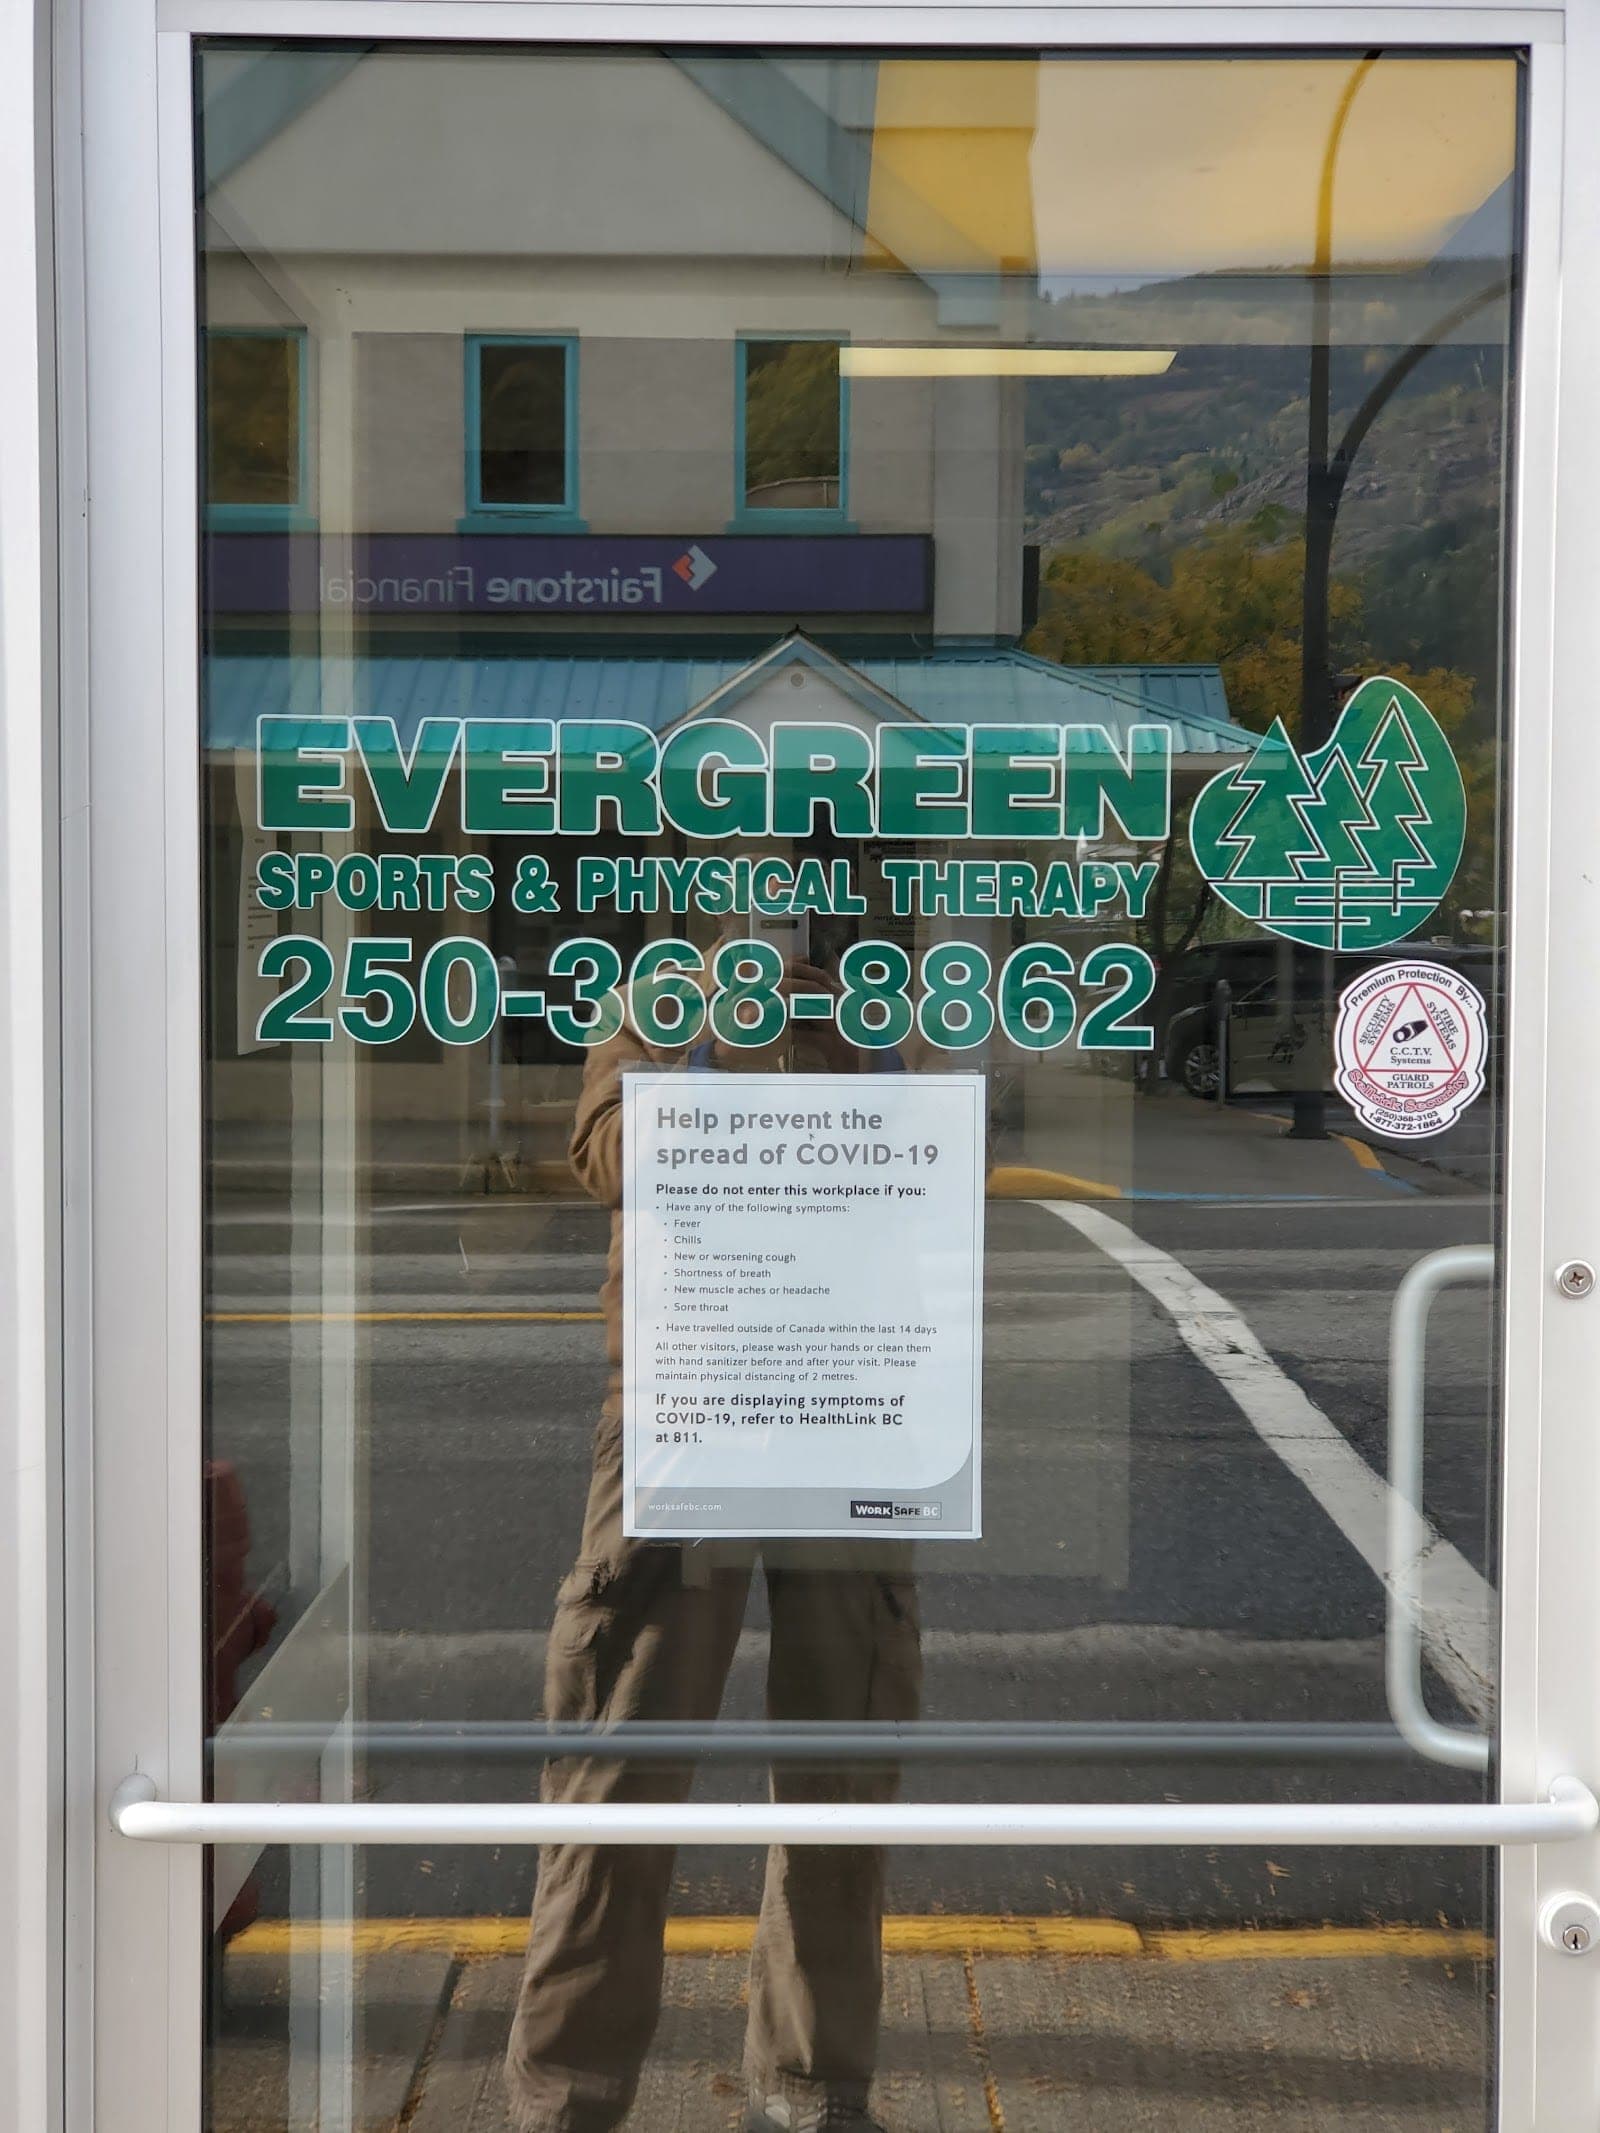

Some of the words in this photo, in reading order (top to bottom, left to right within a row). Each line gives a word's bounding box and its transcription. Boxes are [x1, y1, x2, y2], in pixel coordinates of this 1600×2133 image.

[256, 714, 1173, 841] EVERGREEN
[256, 851, 495, 912] SPORTS
[512, 854, 560, 913] &
[577, 856, 867, 916] PHYSICAL
[881, 859, 1161, 918] THERAPY
[255, 935, 1157, 1052] 250-368-8862
[1351, 973, 1395, 1007] Premium
[1398, 970, 1452, 988] Protection
[1360, 995, 1391, 1045] SECURITY
[1368, 1002, 1396, 1046] SYSTEMS
[1427, 1001, 1456, 1050] SYSTEMS
[1440, 1008, 1459, 1035] FIRE
[1390, 1047, 1432, 1056] C.C.T.V.
[1391, 1056, 1431, 1065] Systems
[1404, 1071, 1469, 1113] Security
[657, 1108, 718, 1134] Help
[730, 1111, 832, 1134] prevent
[841, 1109, 882, 1129] the
[657, 1144, 748, 1169] spread
[759, 1143, 787, 1165] of
[797, 1144, 938, 1166] COVID-19
[656, 1184, 698, 1195] Please
[702, 1184, 718, 1195] do
[723, 1186, 744, 1195] not
[748, 1186, 780, 1196] enter
[784, 1184, 807, 1196] this
[812, 1184, 880, 1198] workplace
[884, 1184, 894, 1196] if
[897, 1186, 926, 1198] you:
[666, 1203, 691, 1212] Have
[694, 1205, 711, 1214] any
[715, 1203, 725, 1212] of
[728, 1203, 744, 1212] the
[747, 1203, 792, 1214] following
[796, 1204, 850, 1214] symptoms:
[674, 1219, 701, 1228] Fever
[674, 1235, 701, 1244] Chills
[674, 1252, 695, 1261] New
[712, 1253, 762, 1263] worsening
[766, 1253, 796, 1263] cough
[674, 1269, 723, 1278] Shortness
[727, 1268, 737, 1278] of
[740, 1269, 771, 1278] breath
[674, 1286, 696, 1294] New
[699, 1286, 734, 1295] muscle
[738, 1286, 767, 1295] aches
[783, 1286, 830, 1295] headache
[674, 1303, 696, 1312] Sore
[699, 1303, 728, 1312] throat
[666, 1324, 690, 1332] Have
[693, 1324, 734, 1333] travelled
[738, 1324, 773, 1333] outside
[776, 1324, 786, 1333] of
[789, 1324, 825, 1333] Canada
[829, 1324, 857, 1333] within
[861, 1324, 875, 1333] the
[878, 1324, 896, 1333] last
[899, 1325, 911, 1334] 14
[914, 1325, 937, 1336] days
[656, 1342, 668, 1351] All
[672, 1342, 697, 1351] other
[701, 1342, 739, 1353] visitors,
[742, 1342, 774, 1354] please
[777, 1342, 802, 1352] wash
[806, 1345, 828, 1354] your
[830, 1343, 860, 1352] hands
[877, 1343, 903, 1352] clean
[906, 1343, 931, 1353] them
[656, 1357, 676, 1366] with
[679, 1357, 703, 1366] hand
[706, 1357, 747, 1366] sanitizer
[751, 1357, 782, 1366] before
[785, 1357, 803, 1367] and
[807, 1357, 828, 1367] after
[832, 1360, 854, 1368] your
[857, 1358, 880, 1367] visit.
[884, 1358, 916, 1367] Please
[656, 1372, 697, 1380] maintain
[700, 1372, 741, 1382] physical
[744, 1372, 795, 1383] distancing
[798, 1372, 808, 1381] of
[812, 1372, 818, 1381] 2
[822, 1372, 858, 1381] metres.
[656, 1393, 666, 1405] If
[671, 1396, 698, 1408] you
[703, 1396, 726, 1405] are
[730, 1394, 805, 1408] displaying
[811, 1395, 885, 1409] symptoms
[890, 1394, 905, 1407] of
[656, 1412, 736, 1426] COVID-19,
[741, 1413, 774, 1424] refer
[780, 1414, 794, 1425] to
[800, 1413, 876, 1425] HealthLink
[882, 1413, 903, 1425] BC
[656, 1433, 669, 1443] at
[673, 1432, 702, 1443] 811.
[648, 1502, 721, 1511] worksafebc.com
